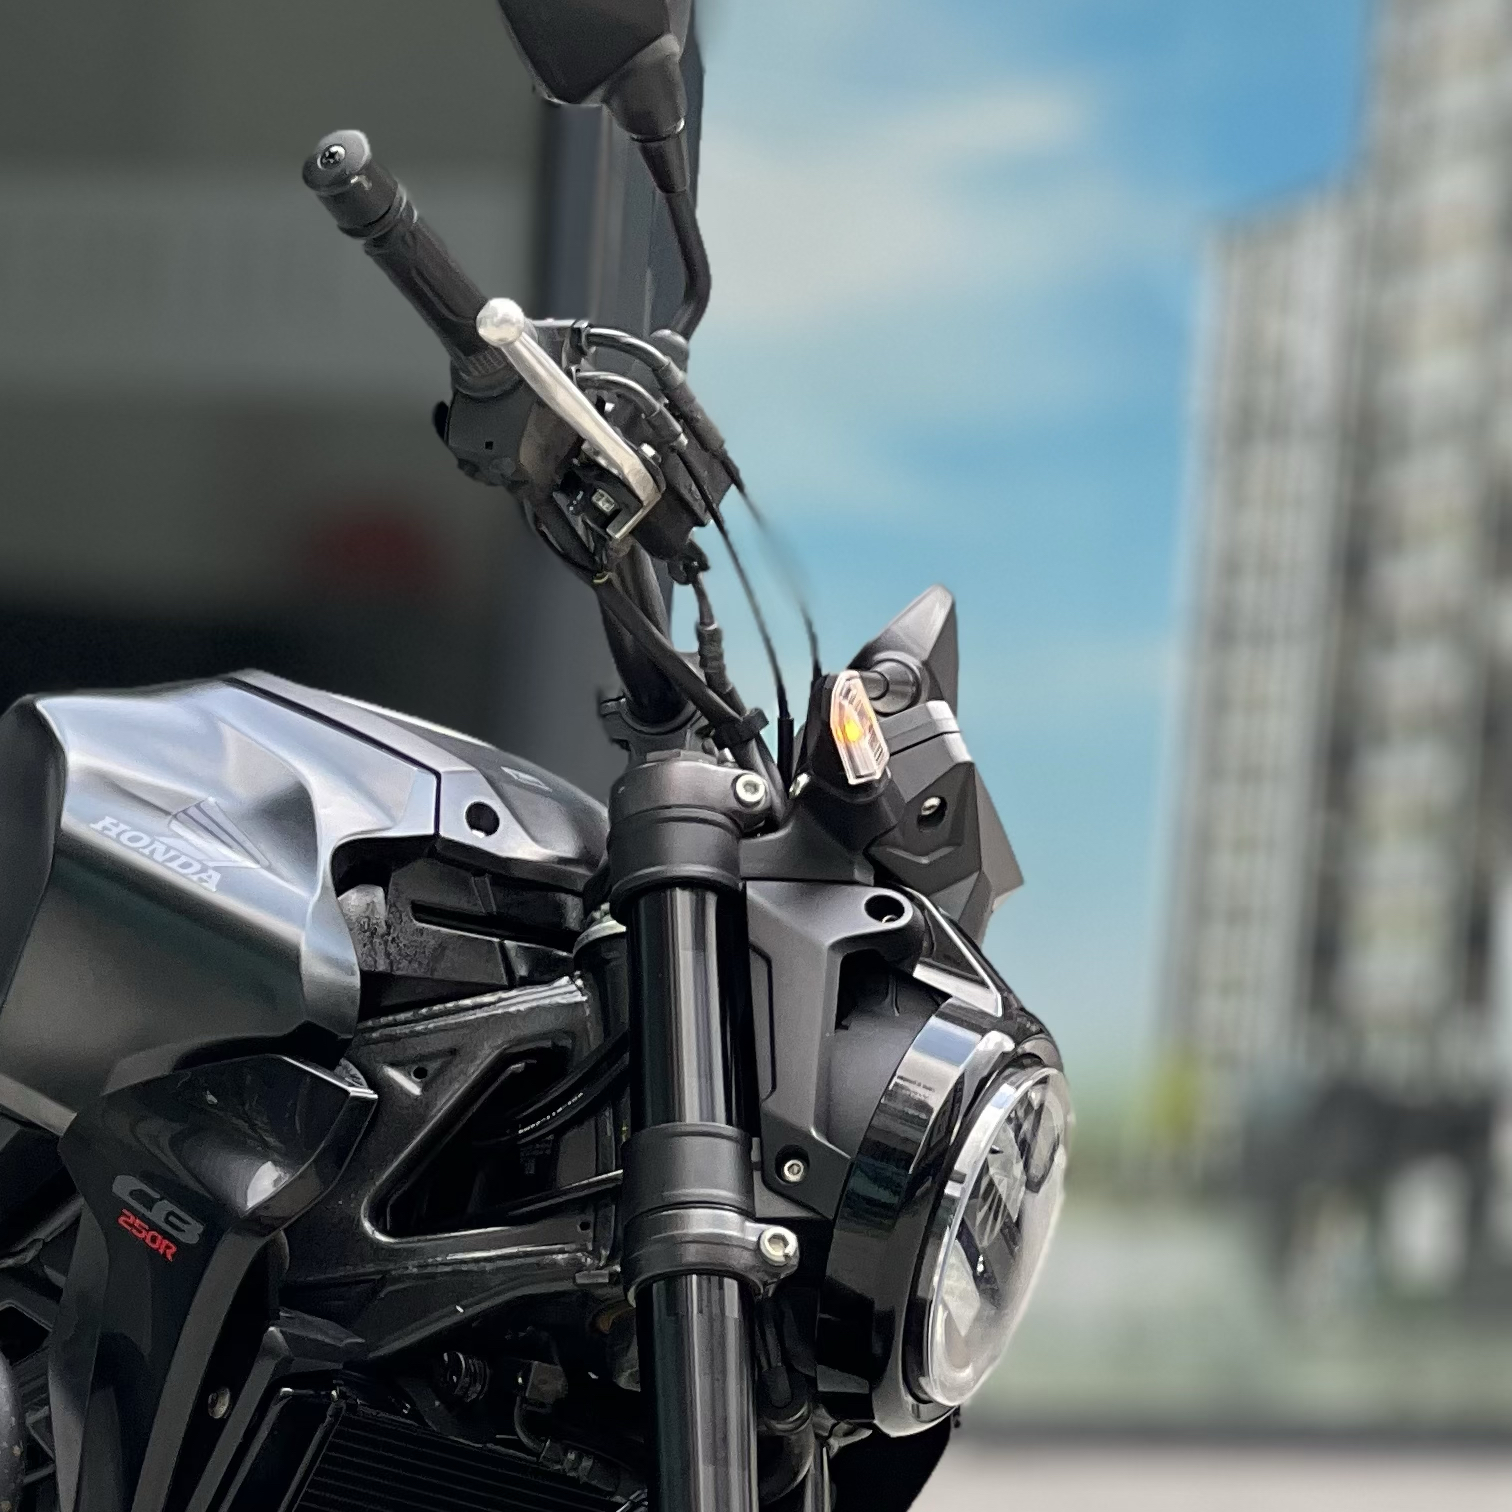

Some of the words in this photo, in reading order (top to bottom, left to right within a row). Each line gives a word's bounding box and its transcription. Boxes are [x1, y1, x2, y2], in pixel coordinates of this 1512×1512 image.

[90, 816, 222, 892] HONDA
[112, 1175, 206, 1244] CB
[117, 1208, 178, 1262] 250R
